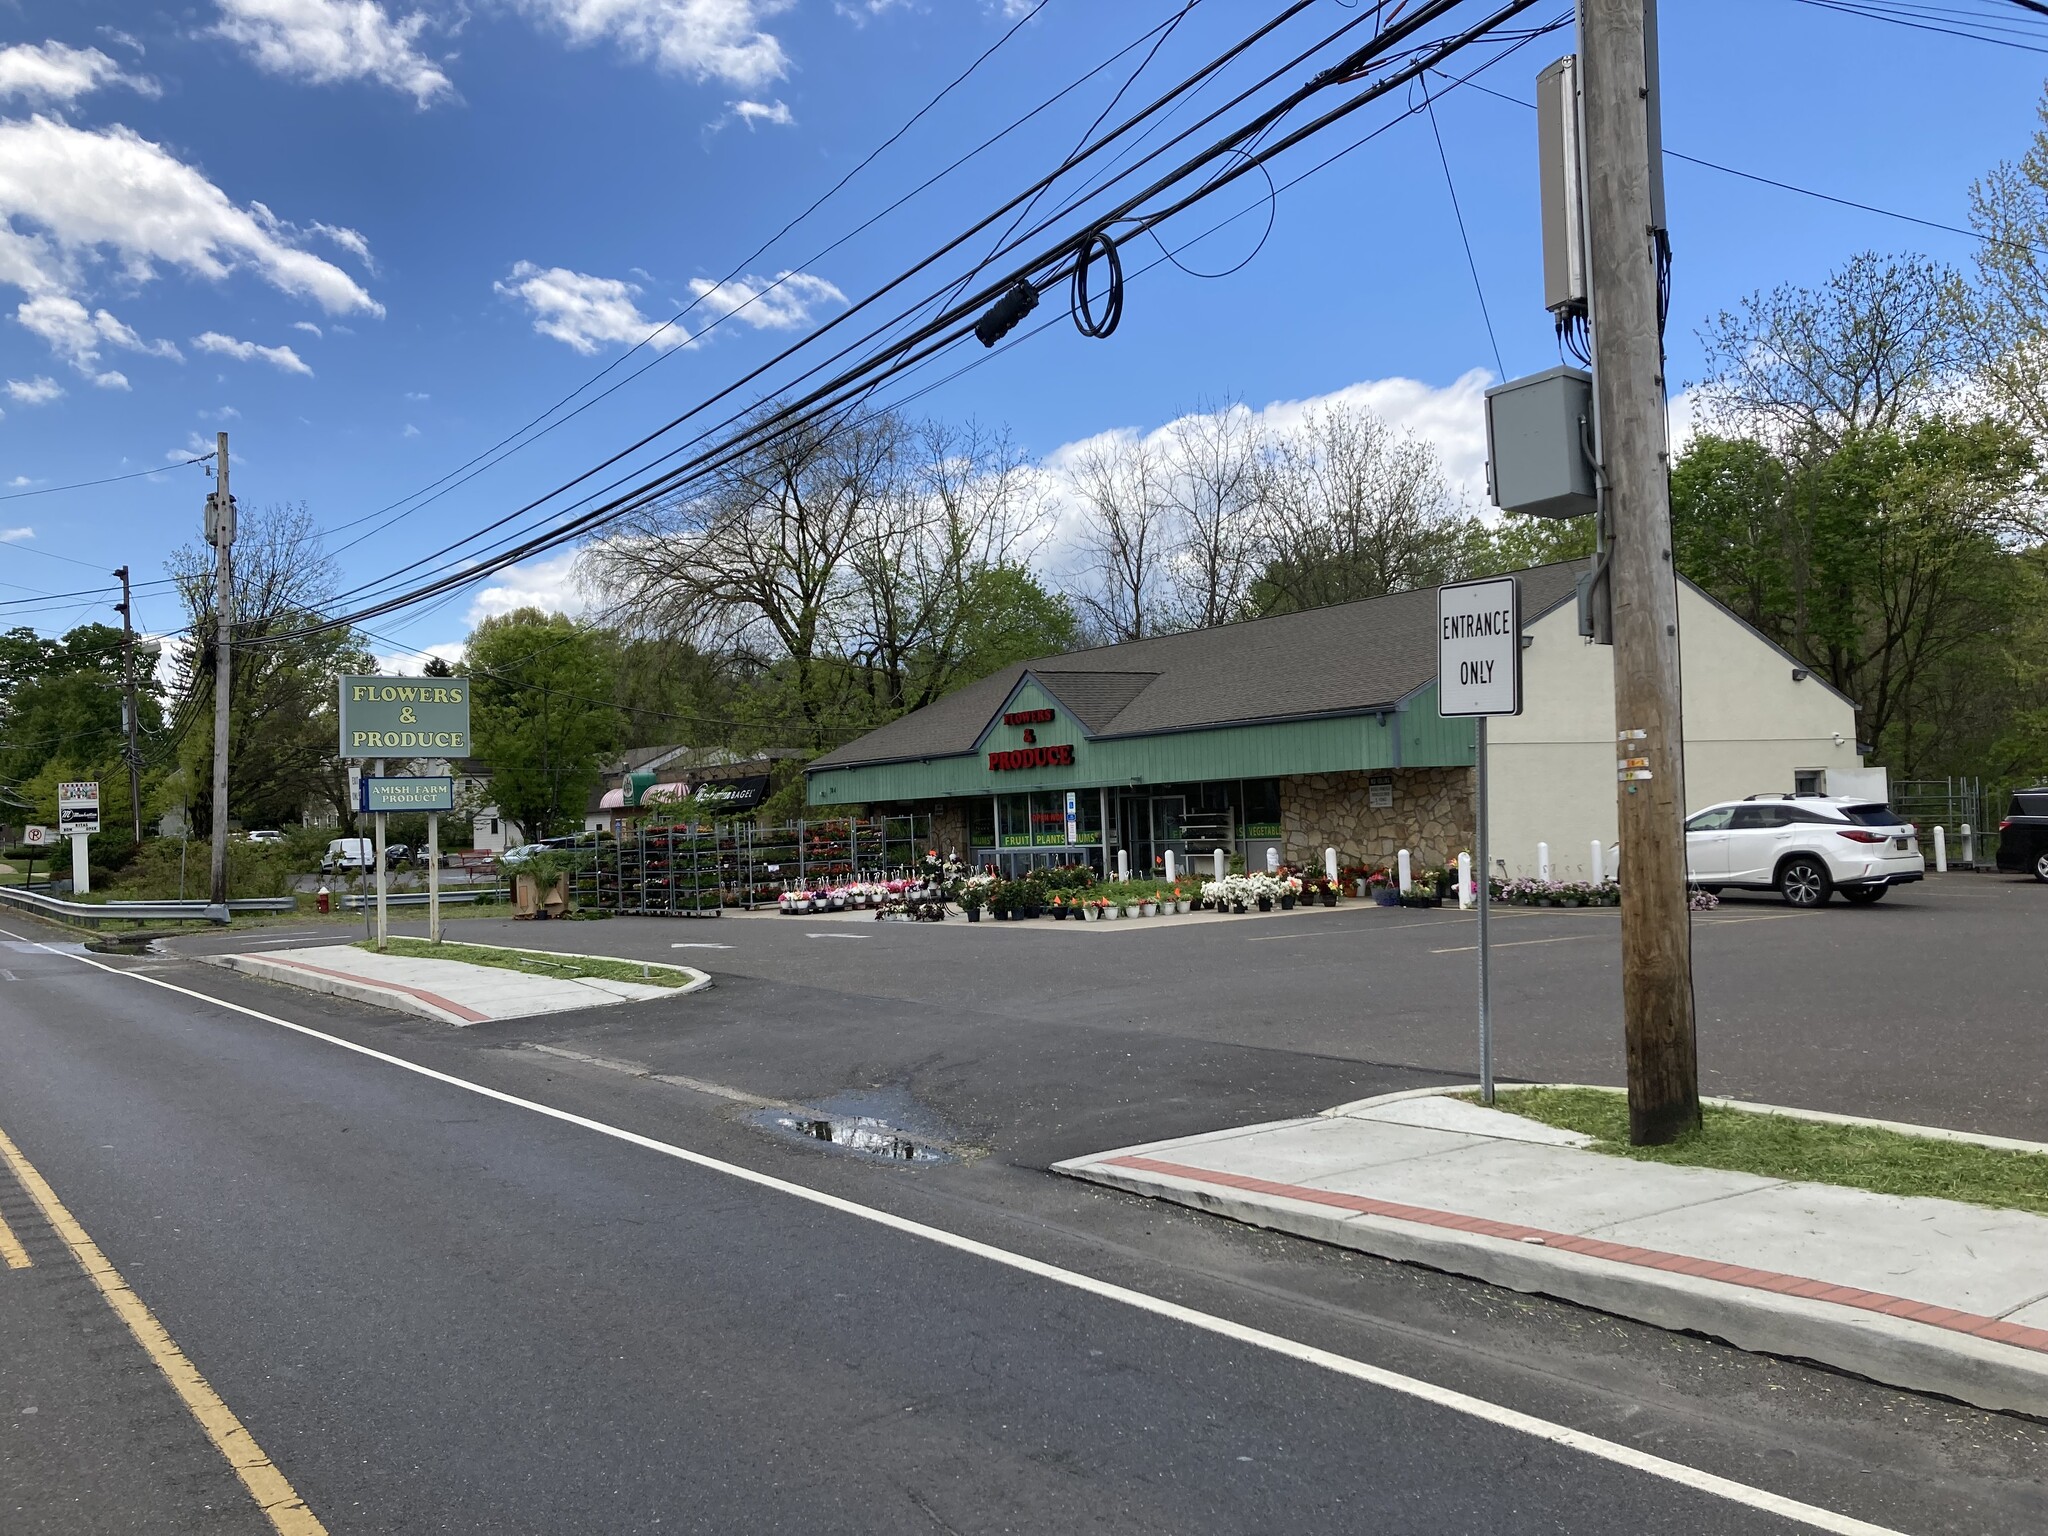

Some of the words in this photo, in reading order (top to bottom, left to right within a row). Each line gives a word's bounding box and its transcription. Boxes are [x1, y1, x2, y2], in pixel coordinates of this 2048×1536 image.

[1443, 610, 1510, 640] ENTRANCE
[1460, 659, 1494, 685] ONLY
[352, 686, 463, 704] FLOWERS
[399, 706, 417, 724] &
[1003, 708, 1054, 726] FLOWERS
[352, 731, 464, 748] PRODUCE
[1023, 729, 1036, 743] &
[988, 744, 1074, 771] PRODUCE
[372, 786, 411, 794] AMISH
[415, 785, 448, 794] FARM
[382, 794, 438, 803] PRODUCT
[1032, 813, 1049, 822] OPEN
[1005, 835, 1030, 846] FRUIT
[1036, 834, 1065, 845] PLANTS
